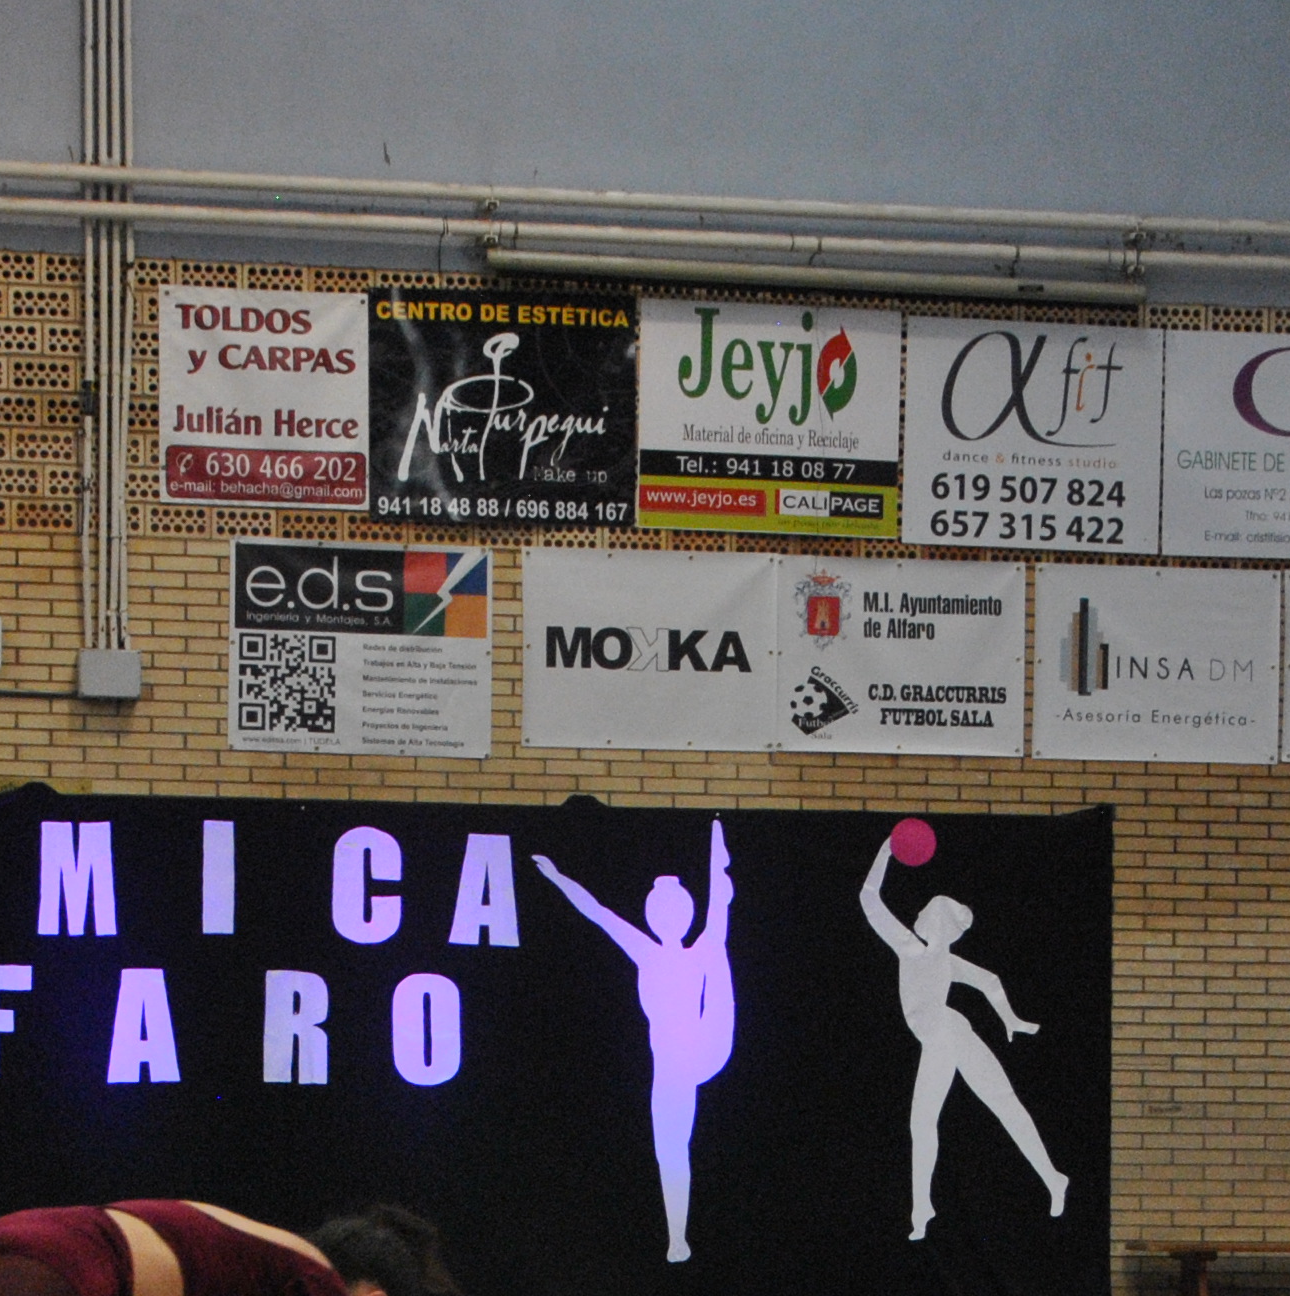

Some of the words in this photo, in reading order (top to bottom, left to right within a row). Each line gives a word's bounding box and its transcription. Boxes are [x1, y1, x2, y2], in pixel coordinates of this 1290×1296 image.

[175, 303, 312, 335] TOLDOS
[376, 301, 472, 322] CENTRO
[480, 304, 509, 323] DE
[518, 303, 629, 328] ESTÉTICA
[187, 349, 207, 374] y
[218, 344, 356, 375] CARPAS
[678, 306, 857, 426] Jeyjo
[173, 404, 262, 435] Julián
[274, 408, 359, 439] Herce
[683, 423, 734, 443] Material
[737, 427, 751, 444] de
[754, 427, 794, 447] oficina
[796, 435, 804, 448] y
[808, 431, 859, 453] Reciclaje
[206, 452, 250, 477] 630
[259, 455, 304, 480] 466
[313, 456, 357, 482] 202
[676, 455, 717, 473] Tel.:
[726, 458, 761, 476] 941
[771, 460, 794, 477] 18
[801, 461, 825, 479] 08
[833, 463, 856, 480] 77
[943, 450, 989, 463] dance
[995, 452, 1005, 464] &
[1011, 453, 1062, 467] fitness
[1068, 454, 1118, 469] studio
[1177, 449, 1257, 472] GABINETE
[1263, 453, 1285, 473] DE
[586, 469, 608, 485] up
[170, 480, 216, 493] e-mail:
[220, 481, 363, 499] behacha@gmail.com
[646, 490, 756, 508] www.jeyjo.es
[931, 472, 991, 501] 619
[999, 475, 1058, 504] 507
[1066, 478, 1126, 508] 824
[1204, 487, 1223, 499] Las
[1226, 490, 1261, 502] pozas
[378, 496, 409, 515] 941
[420, 497, 441, 516] 18
[447, 498, 470, 516] 48
[477, 498, 499, 517] 88
[516, 499, 549, 519] 696
[555, 500, 588, 520] 884
[595, 502, 628, 521] 167
[782, 495, 880, 513] CALIPAGE
[930, 509, 990, 538] 657
[999, 512, 1057, 541] 315
[1066, 515, 1124, 545] 422
[863, 592, 893, 613] M.I.
[900, 593, 1002, 616] Ayuntamiento
[304, 614, 311, 624] y
[863, 618, 882, 638] de
[887, 618, 935, 640] Alfaro
[363, 658, 394, 669] Trabajos
[407, 660, 422, 669] Alta
[810, 665, 860, 715] Graccurris
[868, 684, 897, 701] C.D.
[900, 685, 1007, 705] GRACCURRIS
[880, 708, 947, 727] FUTBOL
[950, 710, 995, 728] SALA
[409, 738, 423, 746] Alta
